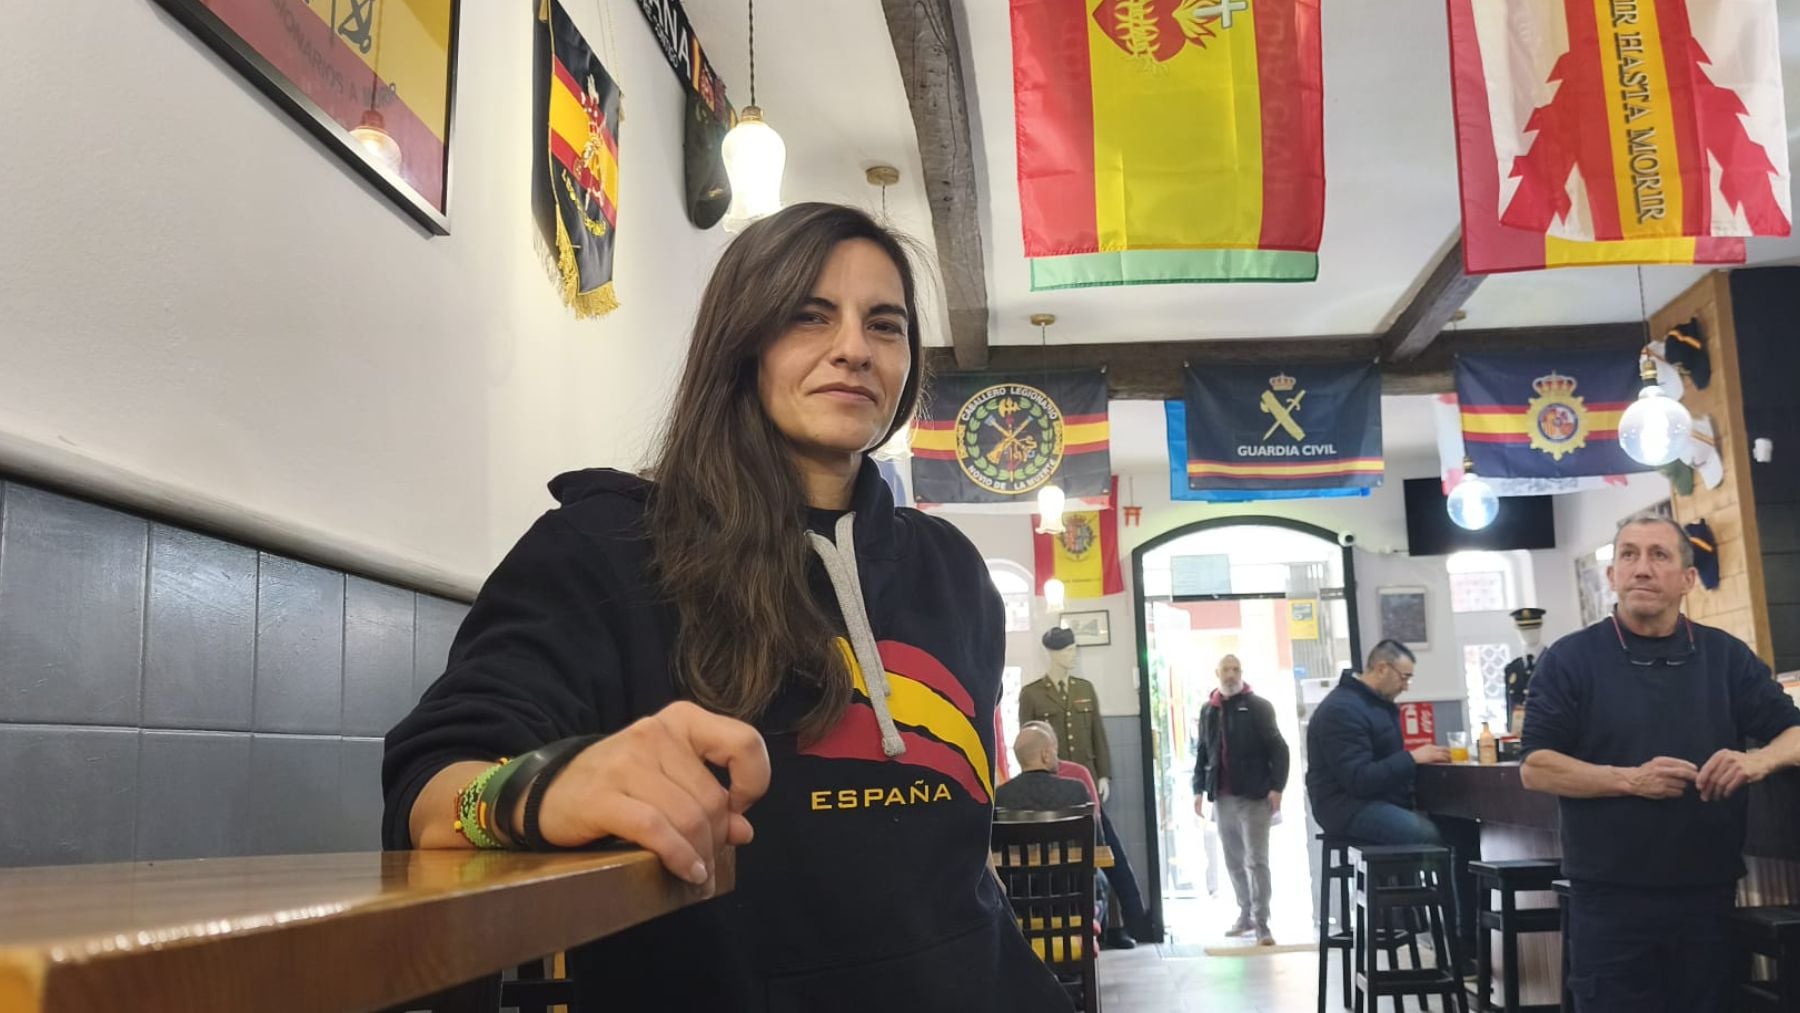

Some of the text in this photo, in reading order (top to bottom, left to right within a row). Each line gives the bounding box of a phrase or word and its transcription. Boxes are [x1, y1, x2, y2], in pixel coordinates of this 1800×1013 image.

[1614, 31, 1653, 124] HASTA
[1627, 126, 1666, 224] MORIR
[961, 386, 1058, 422] CABALLERO LEGIONARIO
[1237, 443, 1337, 457] GUARDIA CIVIL
[968, 459, 1058, 490] NOVIO DE LA MUERTE
[811, 779, 952, 811] ESPAÑA
